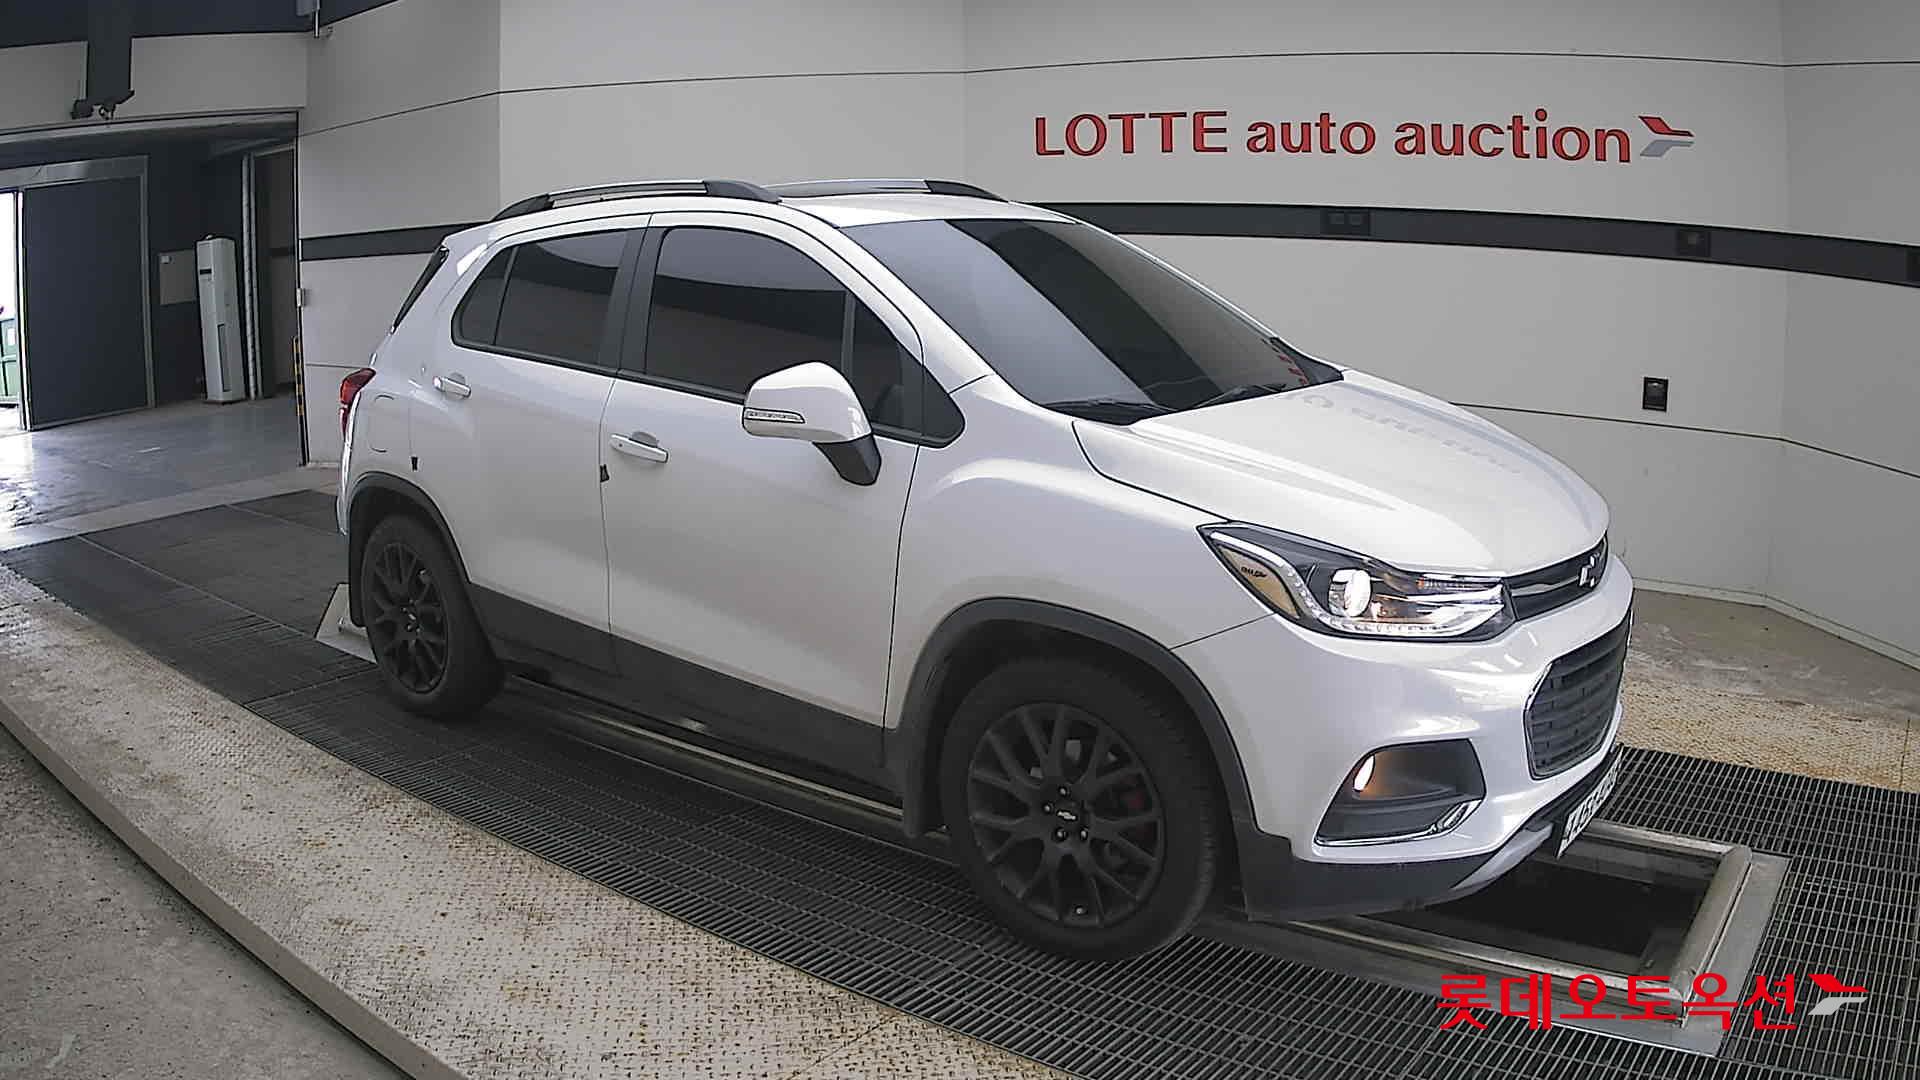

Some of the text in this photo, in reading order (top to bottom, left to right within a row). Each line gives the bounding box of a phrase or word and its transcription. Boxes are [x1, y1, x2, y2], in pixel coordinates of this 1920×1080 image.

[1035, 108, 1632, 164] LOTTE auto auction
